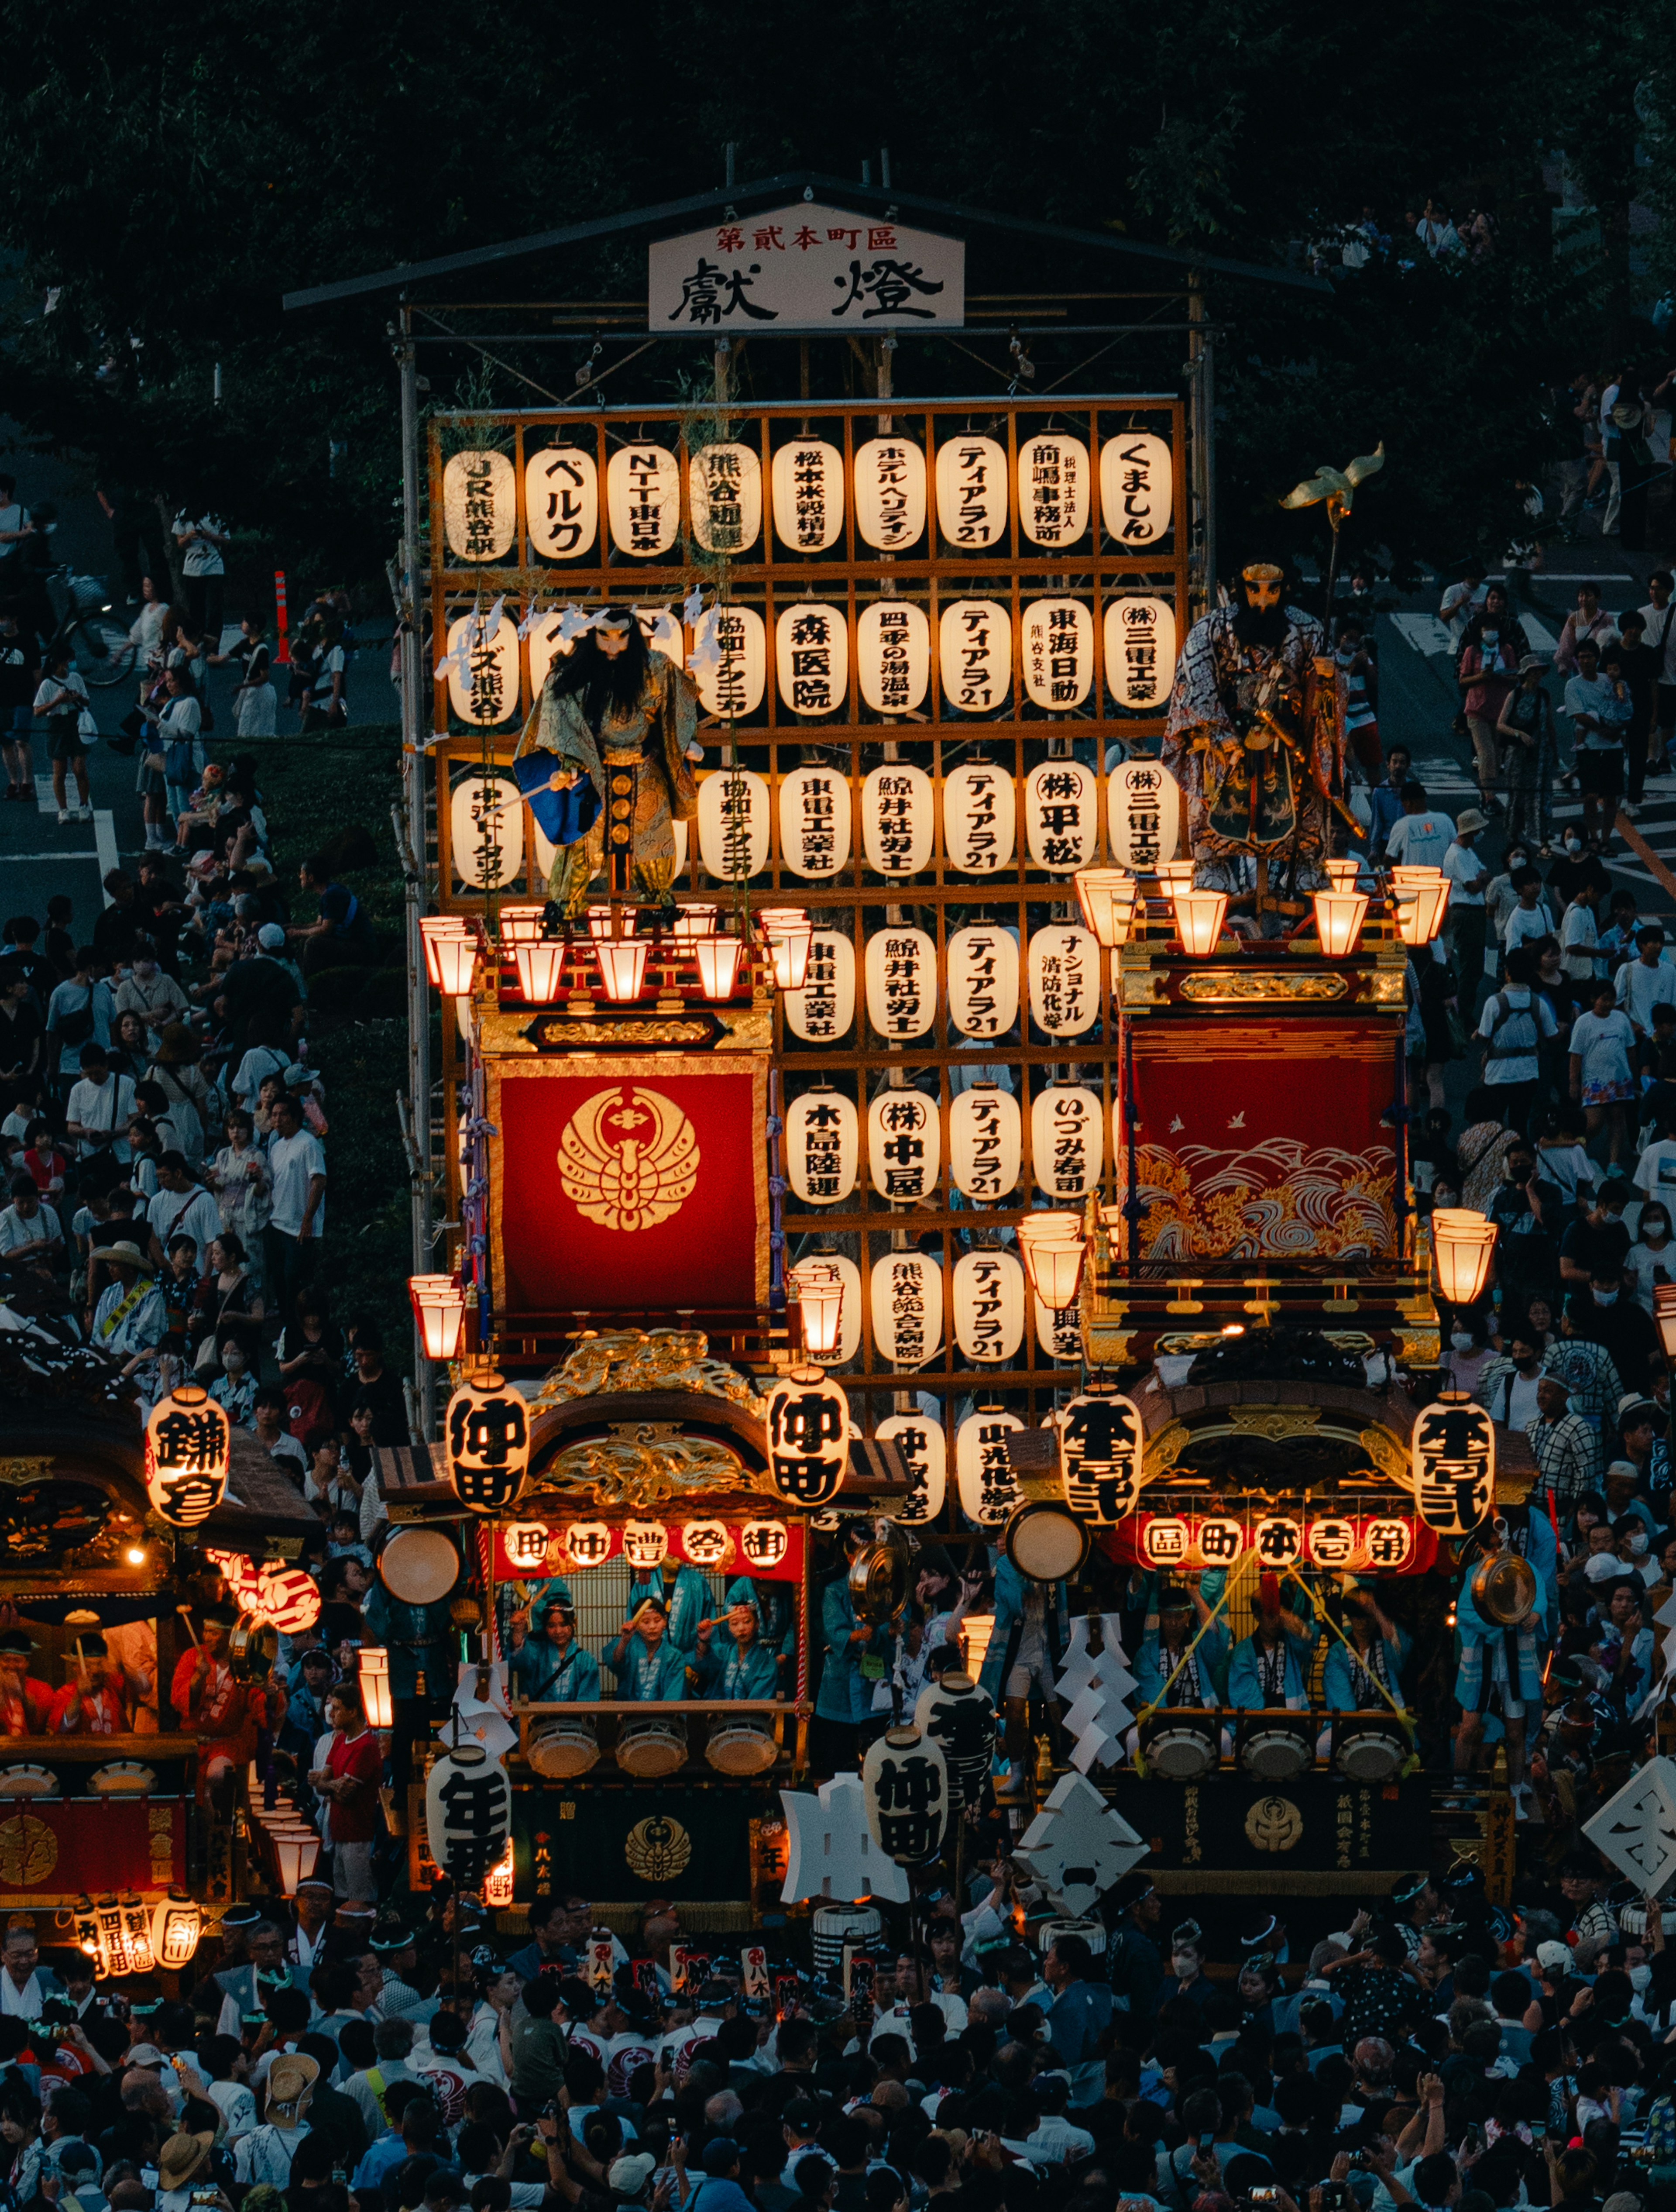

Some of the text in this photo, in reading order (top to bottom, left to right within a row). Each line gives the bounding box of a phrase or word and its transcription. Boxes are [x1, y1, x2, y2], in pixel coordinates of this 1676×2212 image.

[546, 460, 584, 552] ベルク
[629, 454, 661, 550] NTT東日本
[877, 448, 913, 545] ホテルヘリテイジ
[955, 447, 991, 542] ティアラ21
[1064, 456, 1076, 529] 税理士法人
[1120, 443, 1154, 539] くましん
[791, 614, 831, 709] 森医院
[879, 612, 910, 707] 四季の湯温泉
[959, 610, 991, 706] ティアラ21
[1030, 624, 1046, 688] 熊谷支社
[1049, 608, 1078, 702] 東海日動
[801, 778, 835, 870] 東電工業社
[878, 777, 913, 870] 鯨井社労士
[963, 775, 998, 869] ティアラ21
[805, 943, 836, 1036] 東電工業社
[886, 939, 920, 1033] 鯨井社労士
[965, 937, 998, 1032] ティアラ21
[1061, 936, 1084, 1022] ナショナル
[968, 1099, 1001, 1194] ティアラ21
[1054, 1098, 1089, 1192] いづみ寿司
[893, 1262, 924, 1358] 熊谷総合病院
[972, 1260, 1003, 1356] ティアラ21
[450, 1398, 527, 1509] 仲町
[769, 1392, 844, 1503] 仲町
[875, 1756, 943, 1858] 仲町
